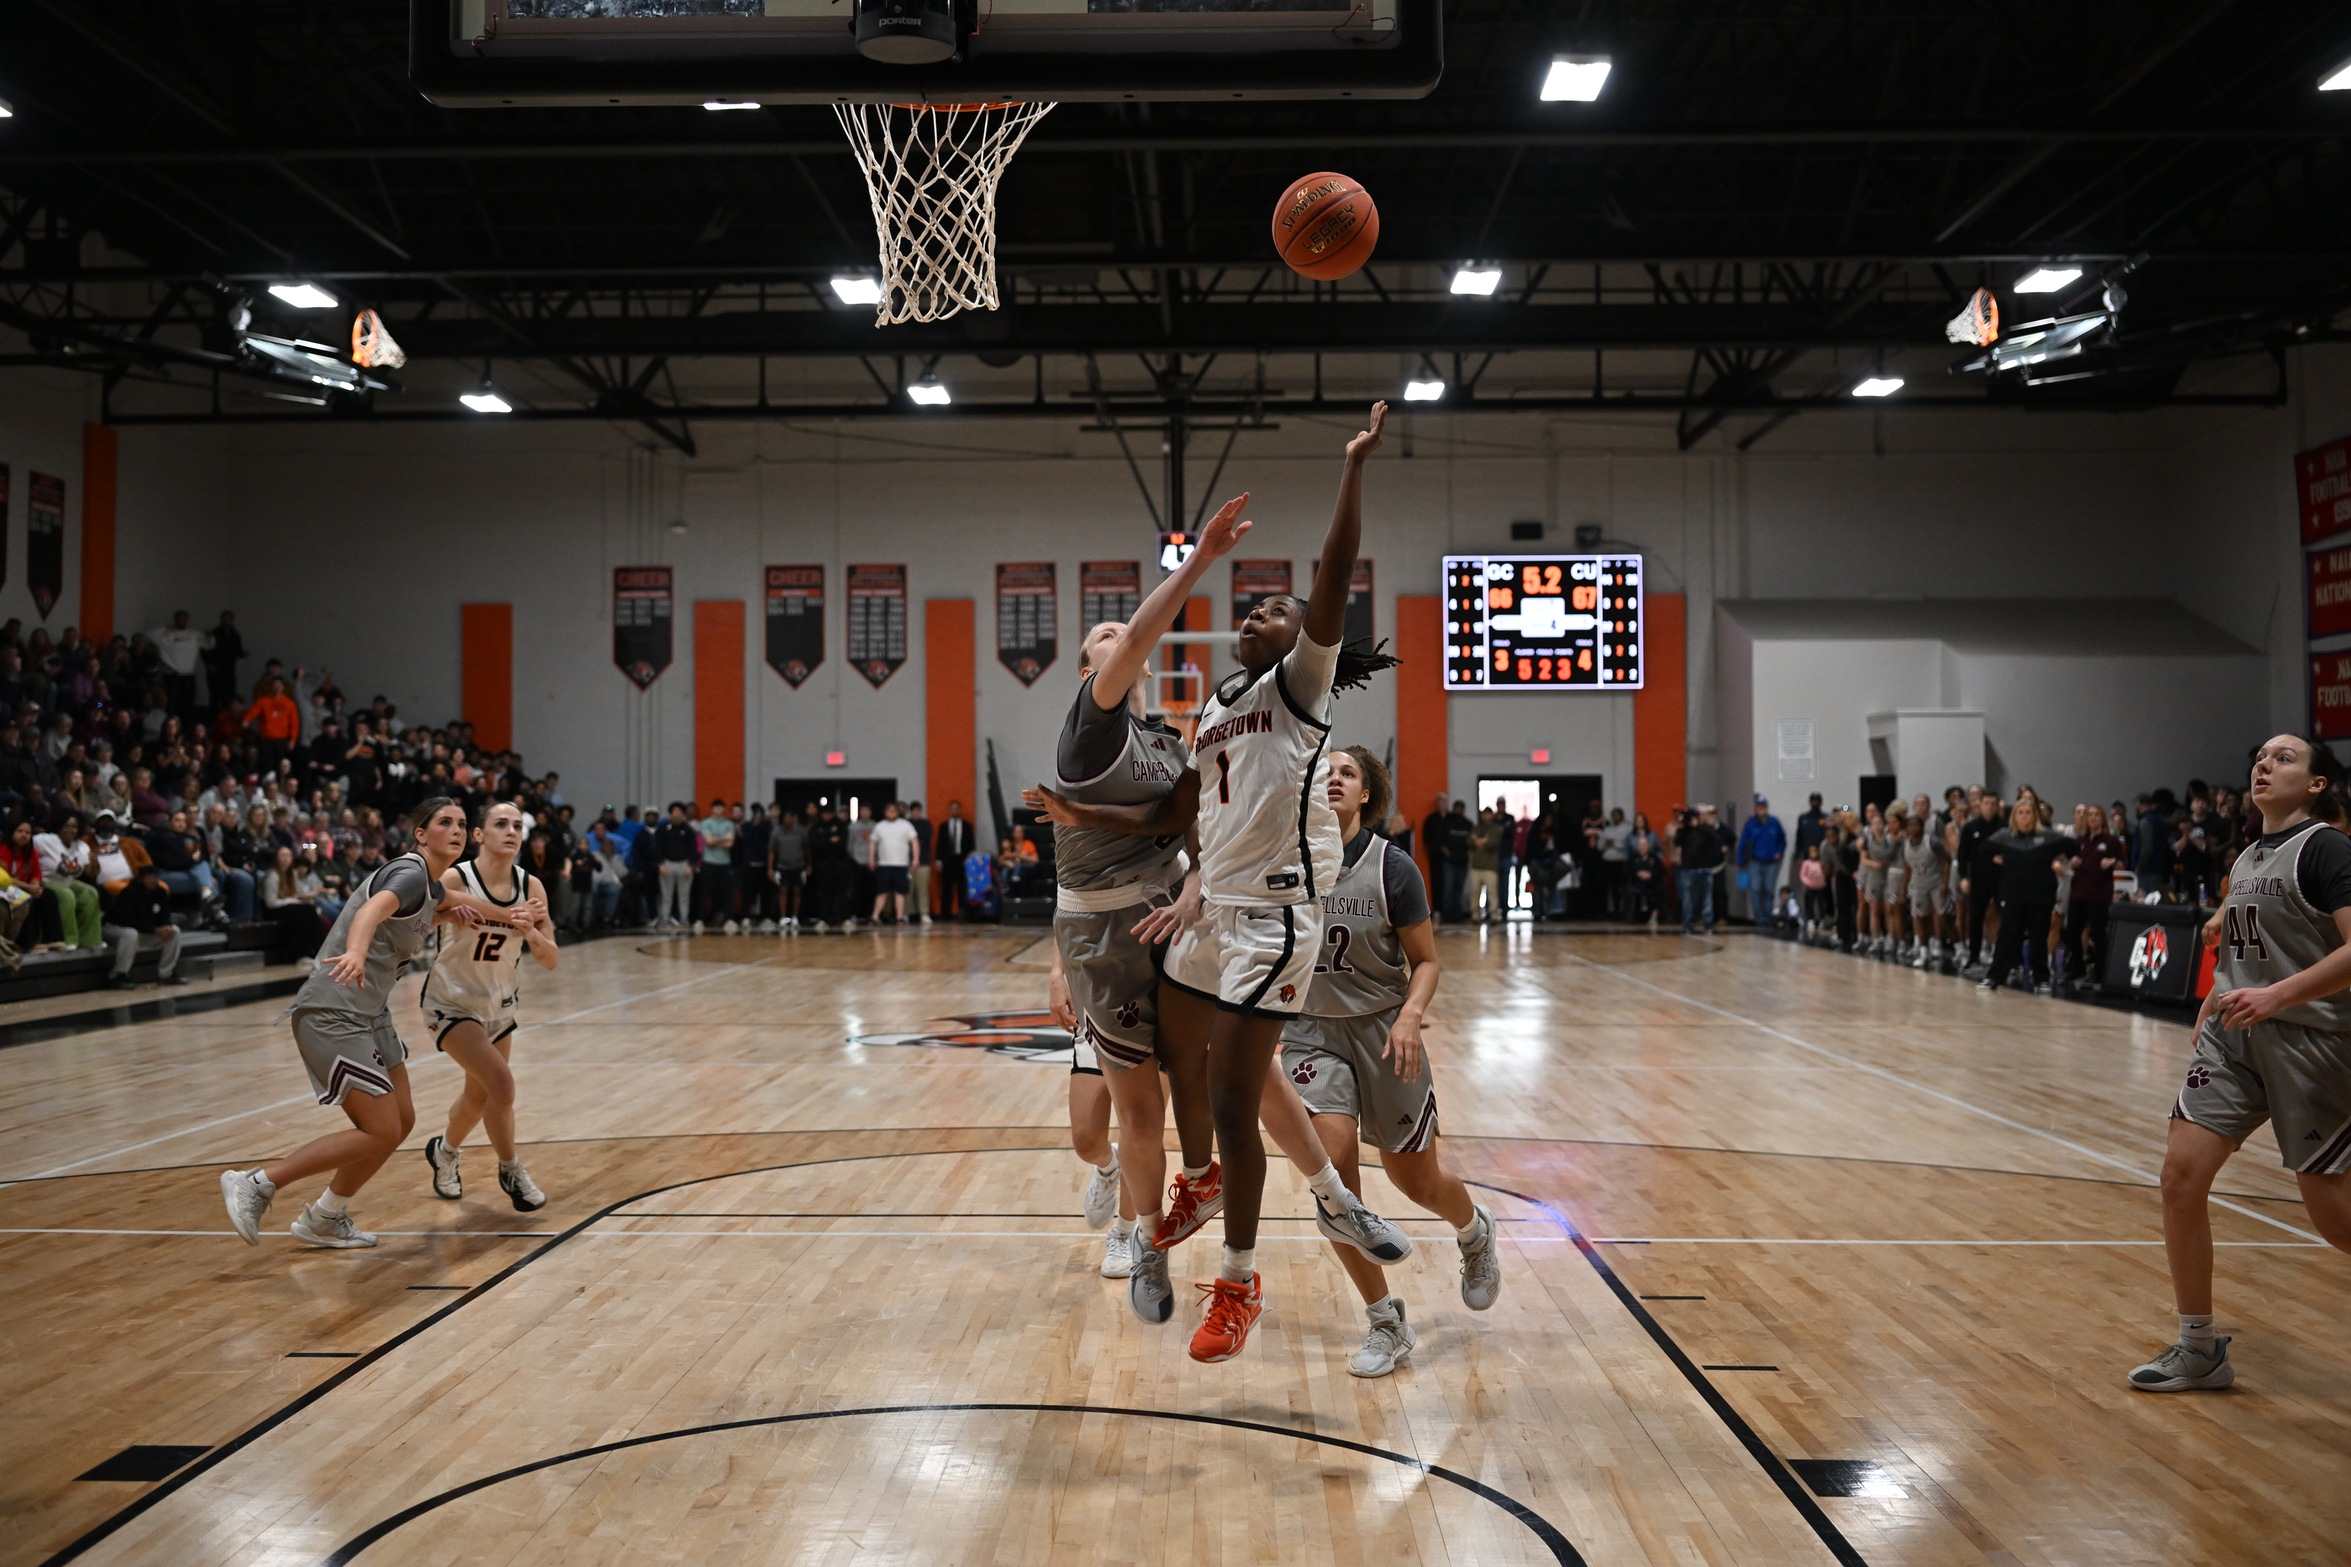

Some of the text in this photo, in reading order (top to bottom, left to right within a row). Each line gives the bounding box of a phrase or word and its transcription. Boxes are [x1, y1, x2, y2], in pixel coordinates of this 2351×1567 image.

[1282, 179, 1347, 232] SPALDING
[1301, 202, 1355, 250] LEGACY
[2309, 470, 2351, 506] FOOTBAL
[1523, 566, 1562, 594] 5.2
[1571, 563, 1597, 580] CU
[1538, 658, 1552, 680] 2
[1578, 650, 1592, 670] 4
[1216, 749, 1230, 805] 1
[473, 931, 507, 961] 12
[2228, 903, 2269, 962] 44
